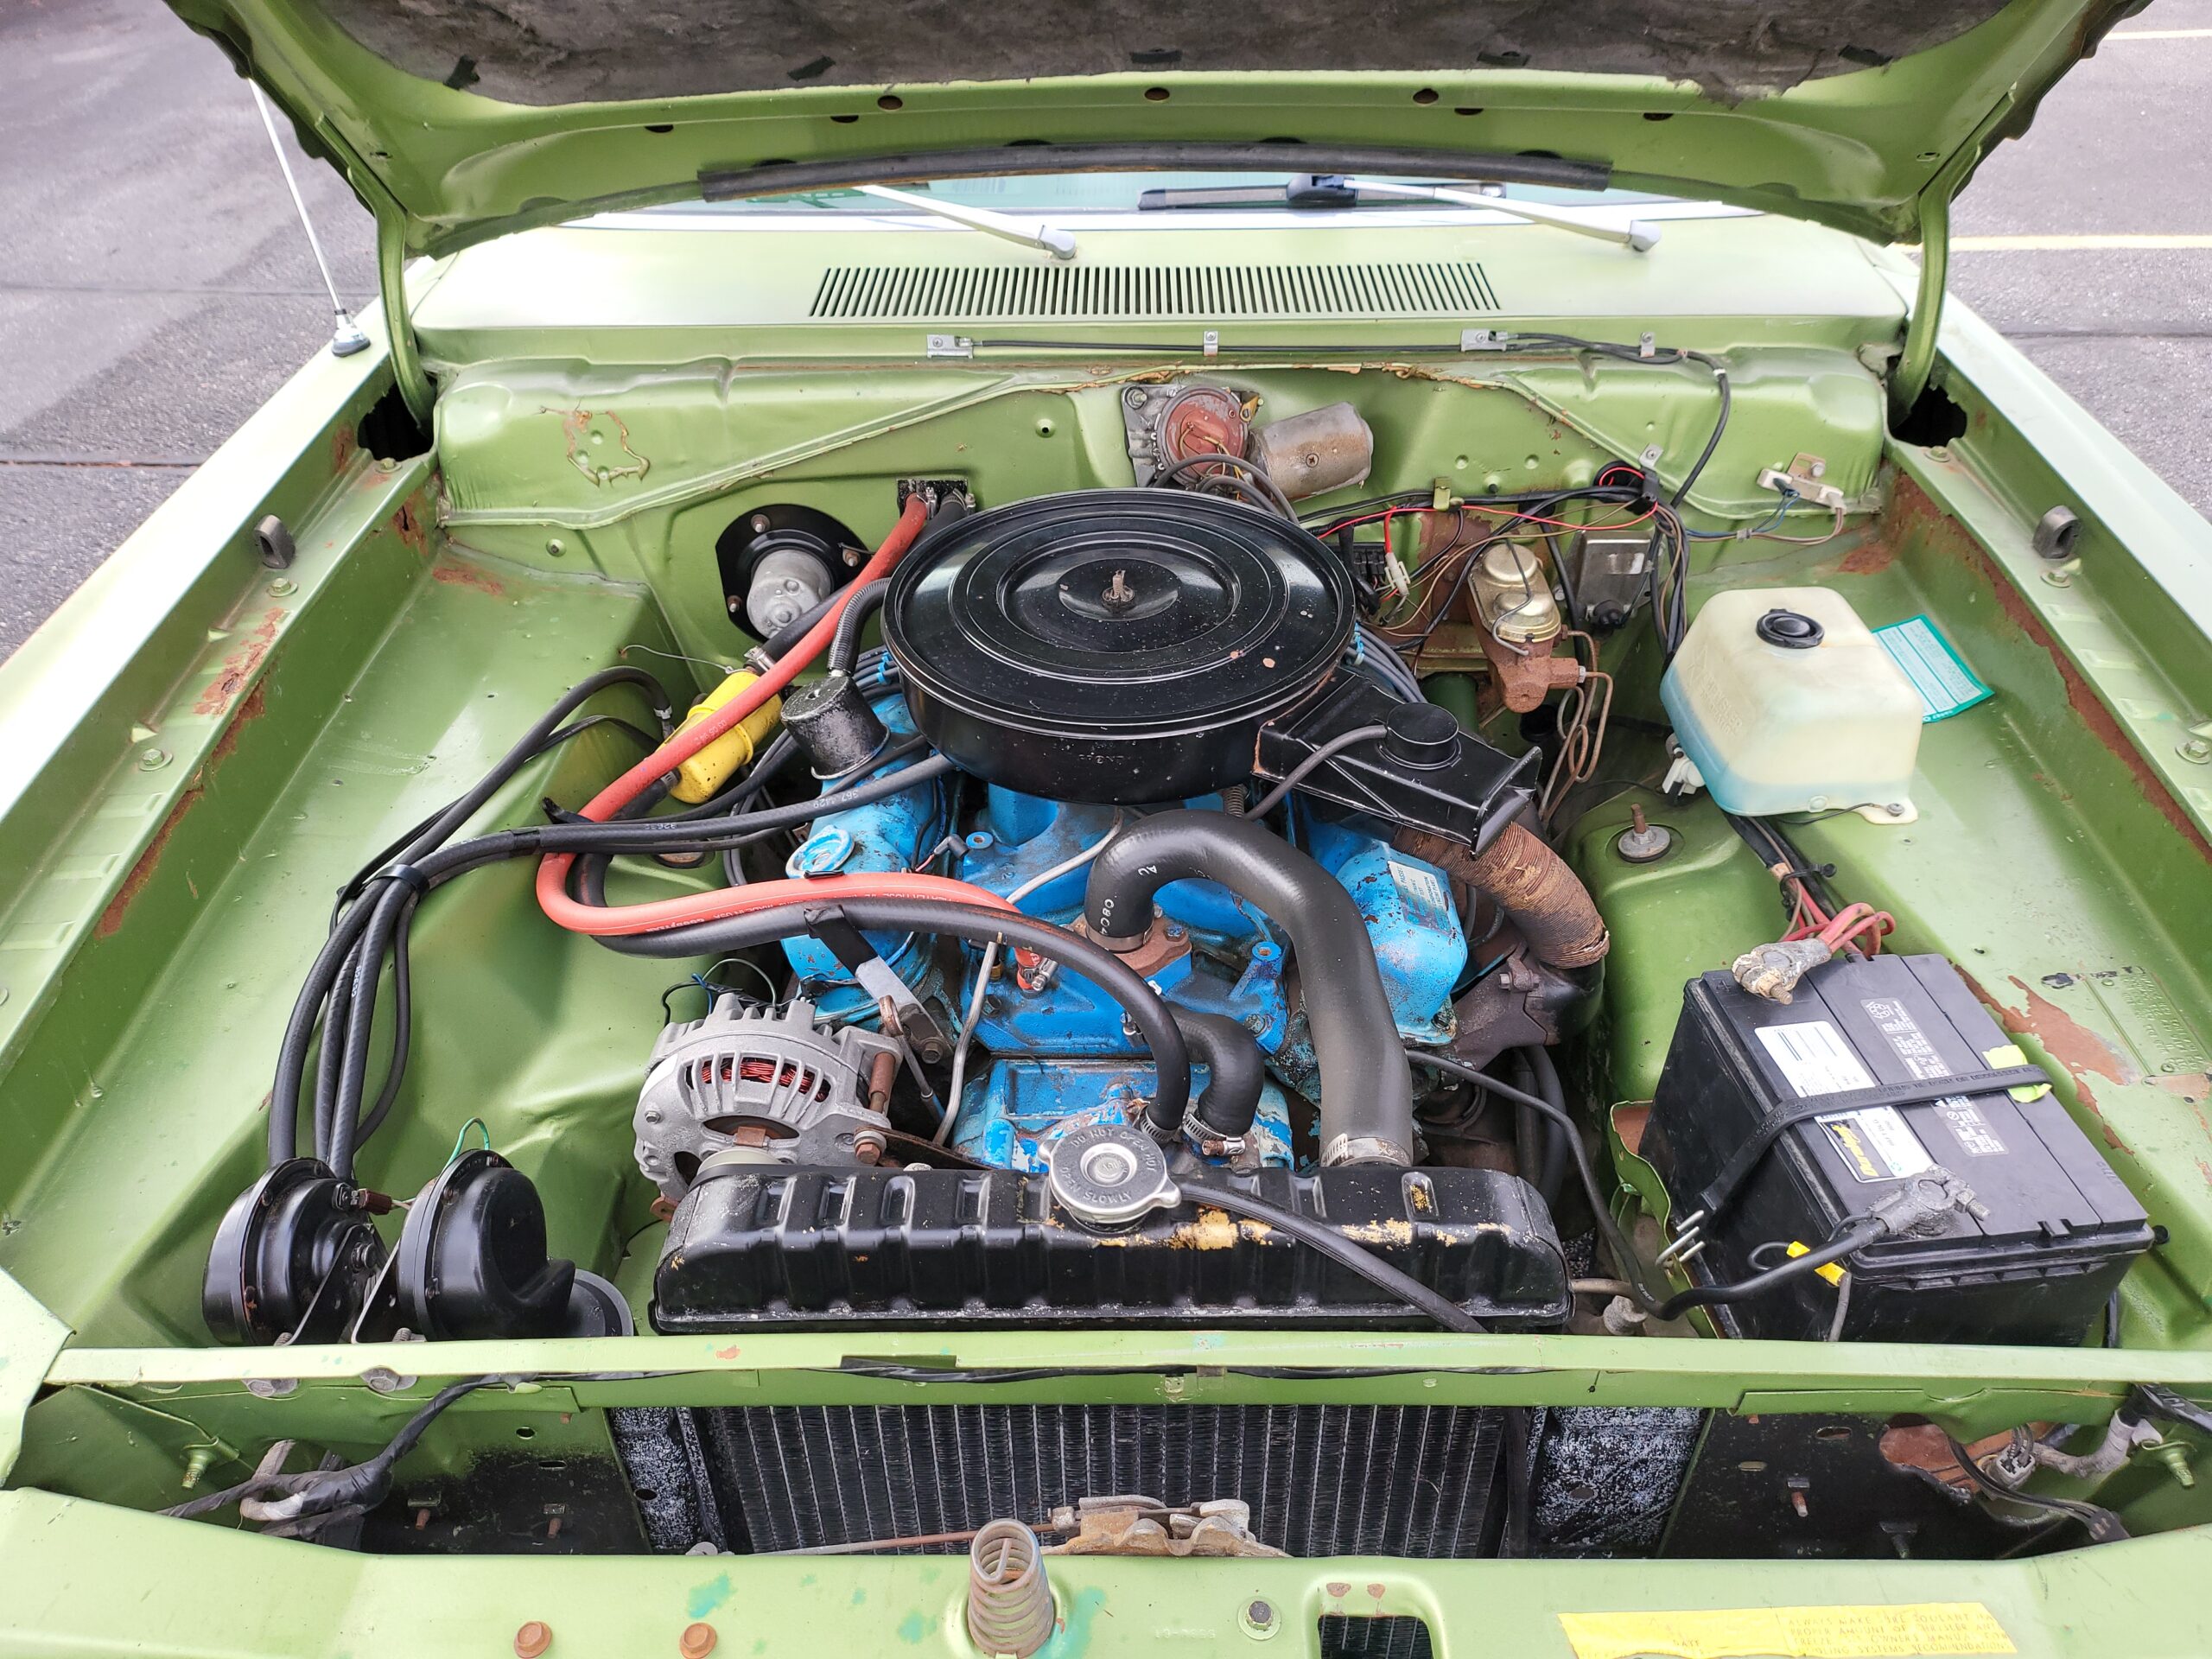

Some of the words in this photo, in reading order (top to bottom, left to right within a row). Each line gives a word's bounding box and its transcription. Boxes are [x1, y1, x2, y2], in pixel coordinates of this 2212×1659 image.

[1138, 865, 1158, 876] AU
[1099, 899, 1115, 936] 0804
[1120, 1131, 1149, 1151] OPEN
[1145, 1154, 1158, 1172] HOT
[1059, 1166, 1081, 1192] OPEN
[1084, 1192, 1132, 1204] SLOWLY
[1858, 1645, 1904, 1654] SYSTEMS
